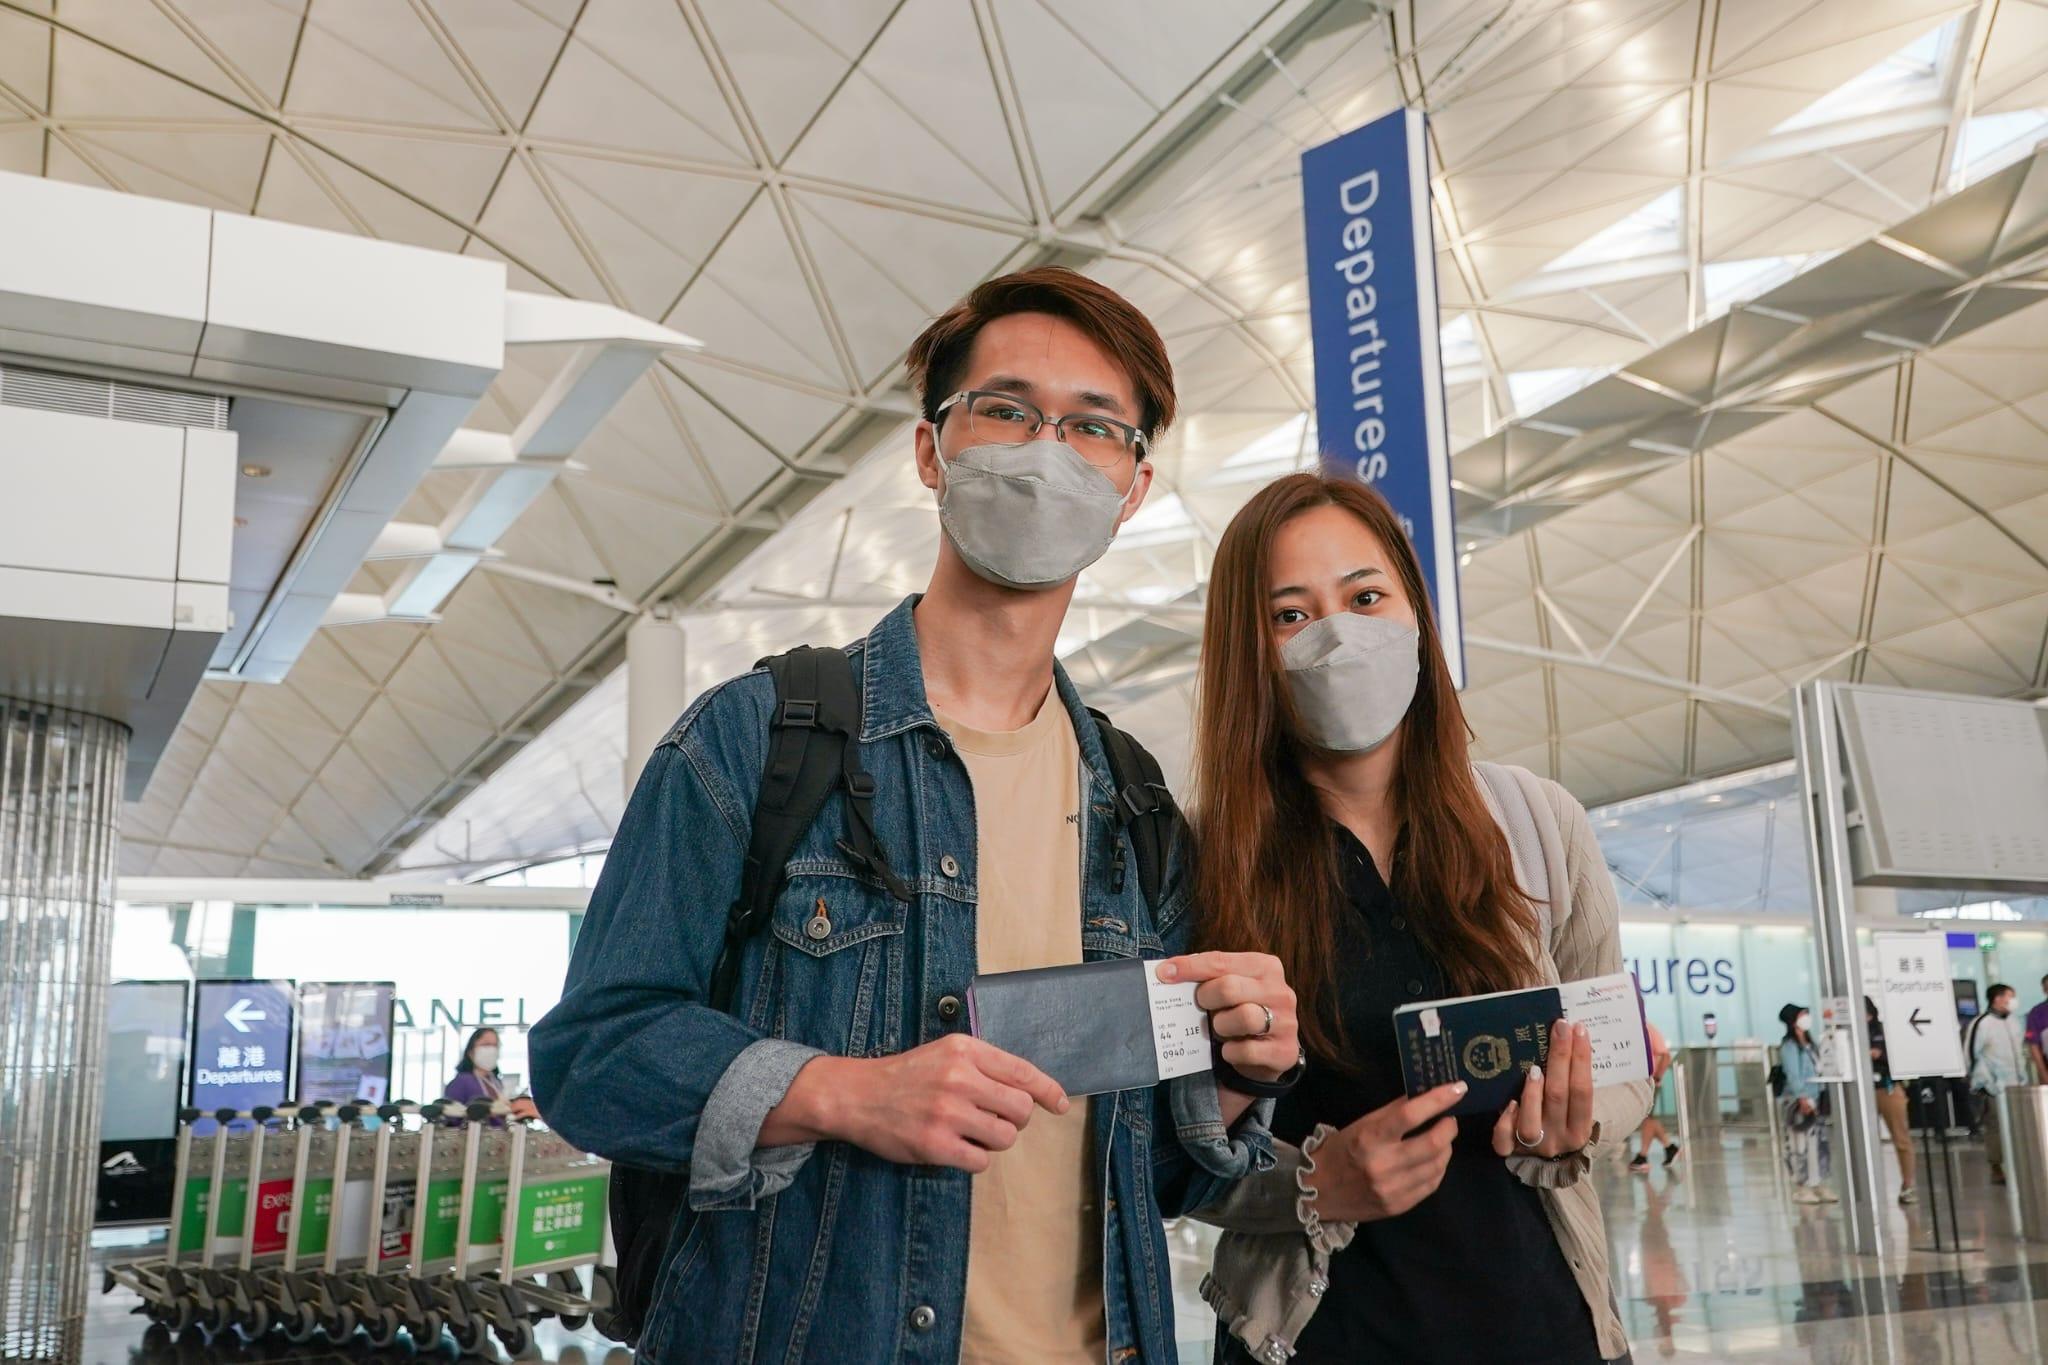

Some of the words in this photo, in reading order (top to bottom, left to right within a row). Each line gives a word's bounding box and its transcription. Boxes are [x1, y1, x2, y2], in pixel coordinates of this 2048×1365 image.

[1334, 169, 1388, 485] Departures
[1633, 958, 1735, 995] ures
[1885, 979, 1945, 994] Departures
[1163, 1048, 1185, 1060] 0940
[1592, 1060, 1613, 1071] 940
[197, 1069, 284, 1088] Departures
